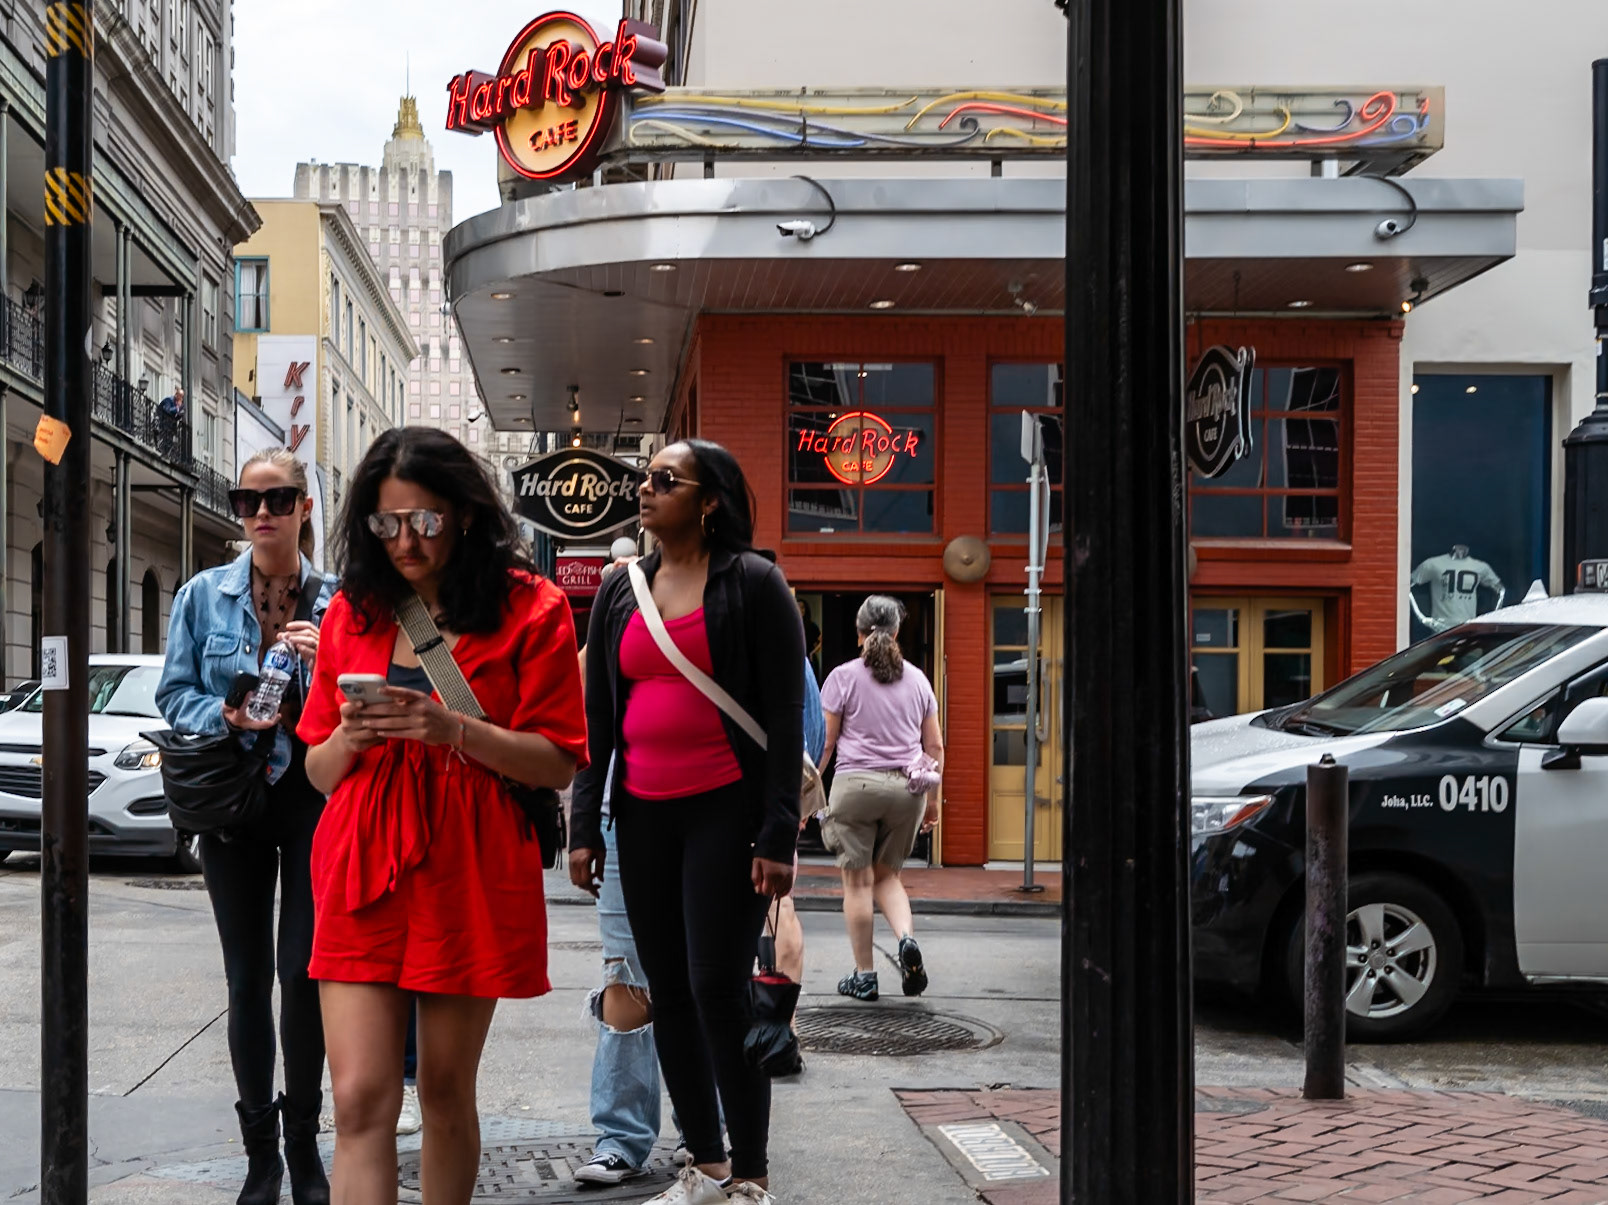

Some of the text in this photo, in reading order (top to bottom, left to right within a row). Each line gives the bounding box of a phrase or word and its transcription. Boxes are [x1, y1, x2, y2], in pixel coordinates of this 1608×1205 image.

[446, 18, 641, 130] Hard Rock
[527, 120, 579, 152] CAFE
[1210, 376, 1238, 423] Rock
[284, 361, 311, 470] Kry
[797, 428, 919, 459] Hard Rock
[1203, 427, 1218, 442] CAFE
[520, 472, 636, 502] Hard Rock
[564, 503, 593, 514] CAFE
[562, 575, 592, 586] GRILL
[1442, 569, 1479, 595] 10
[1410, 794, 1434, 808] LLC.
[1438, 774, 1509, 813] 0410
